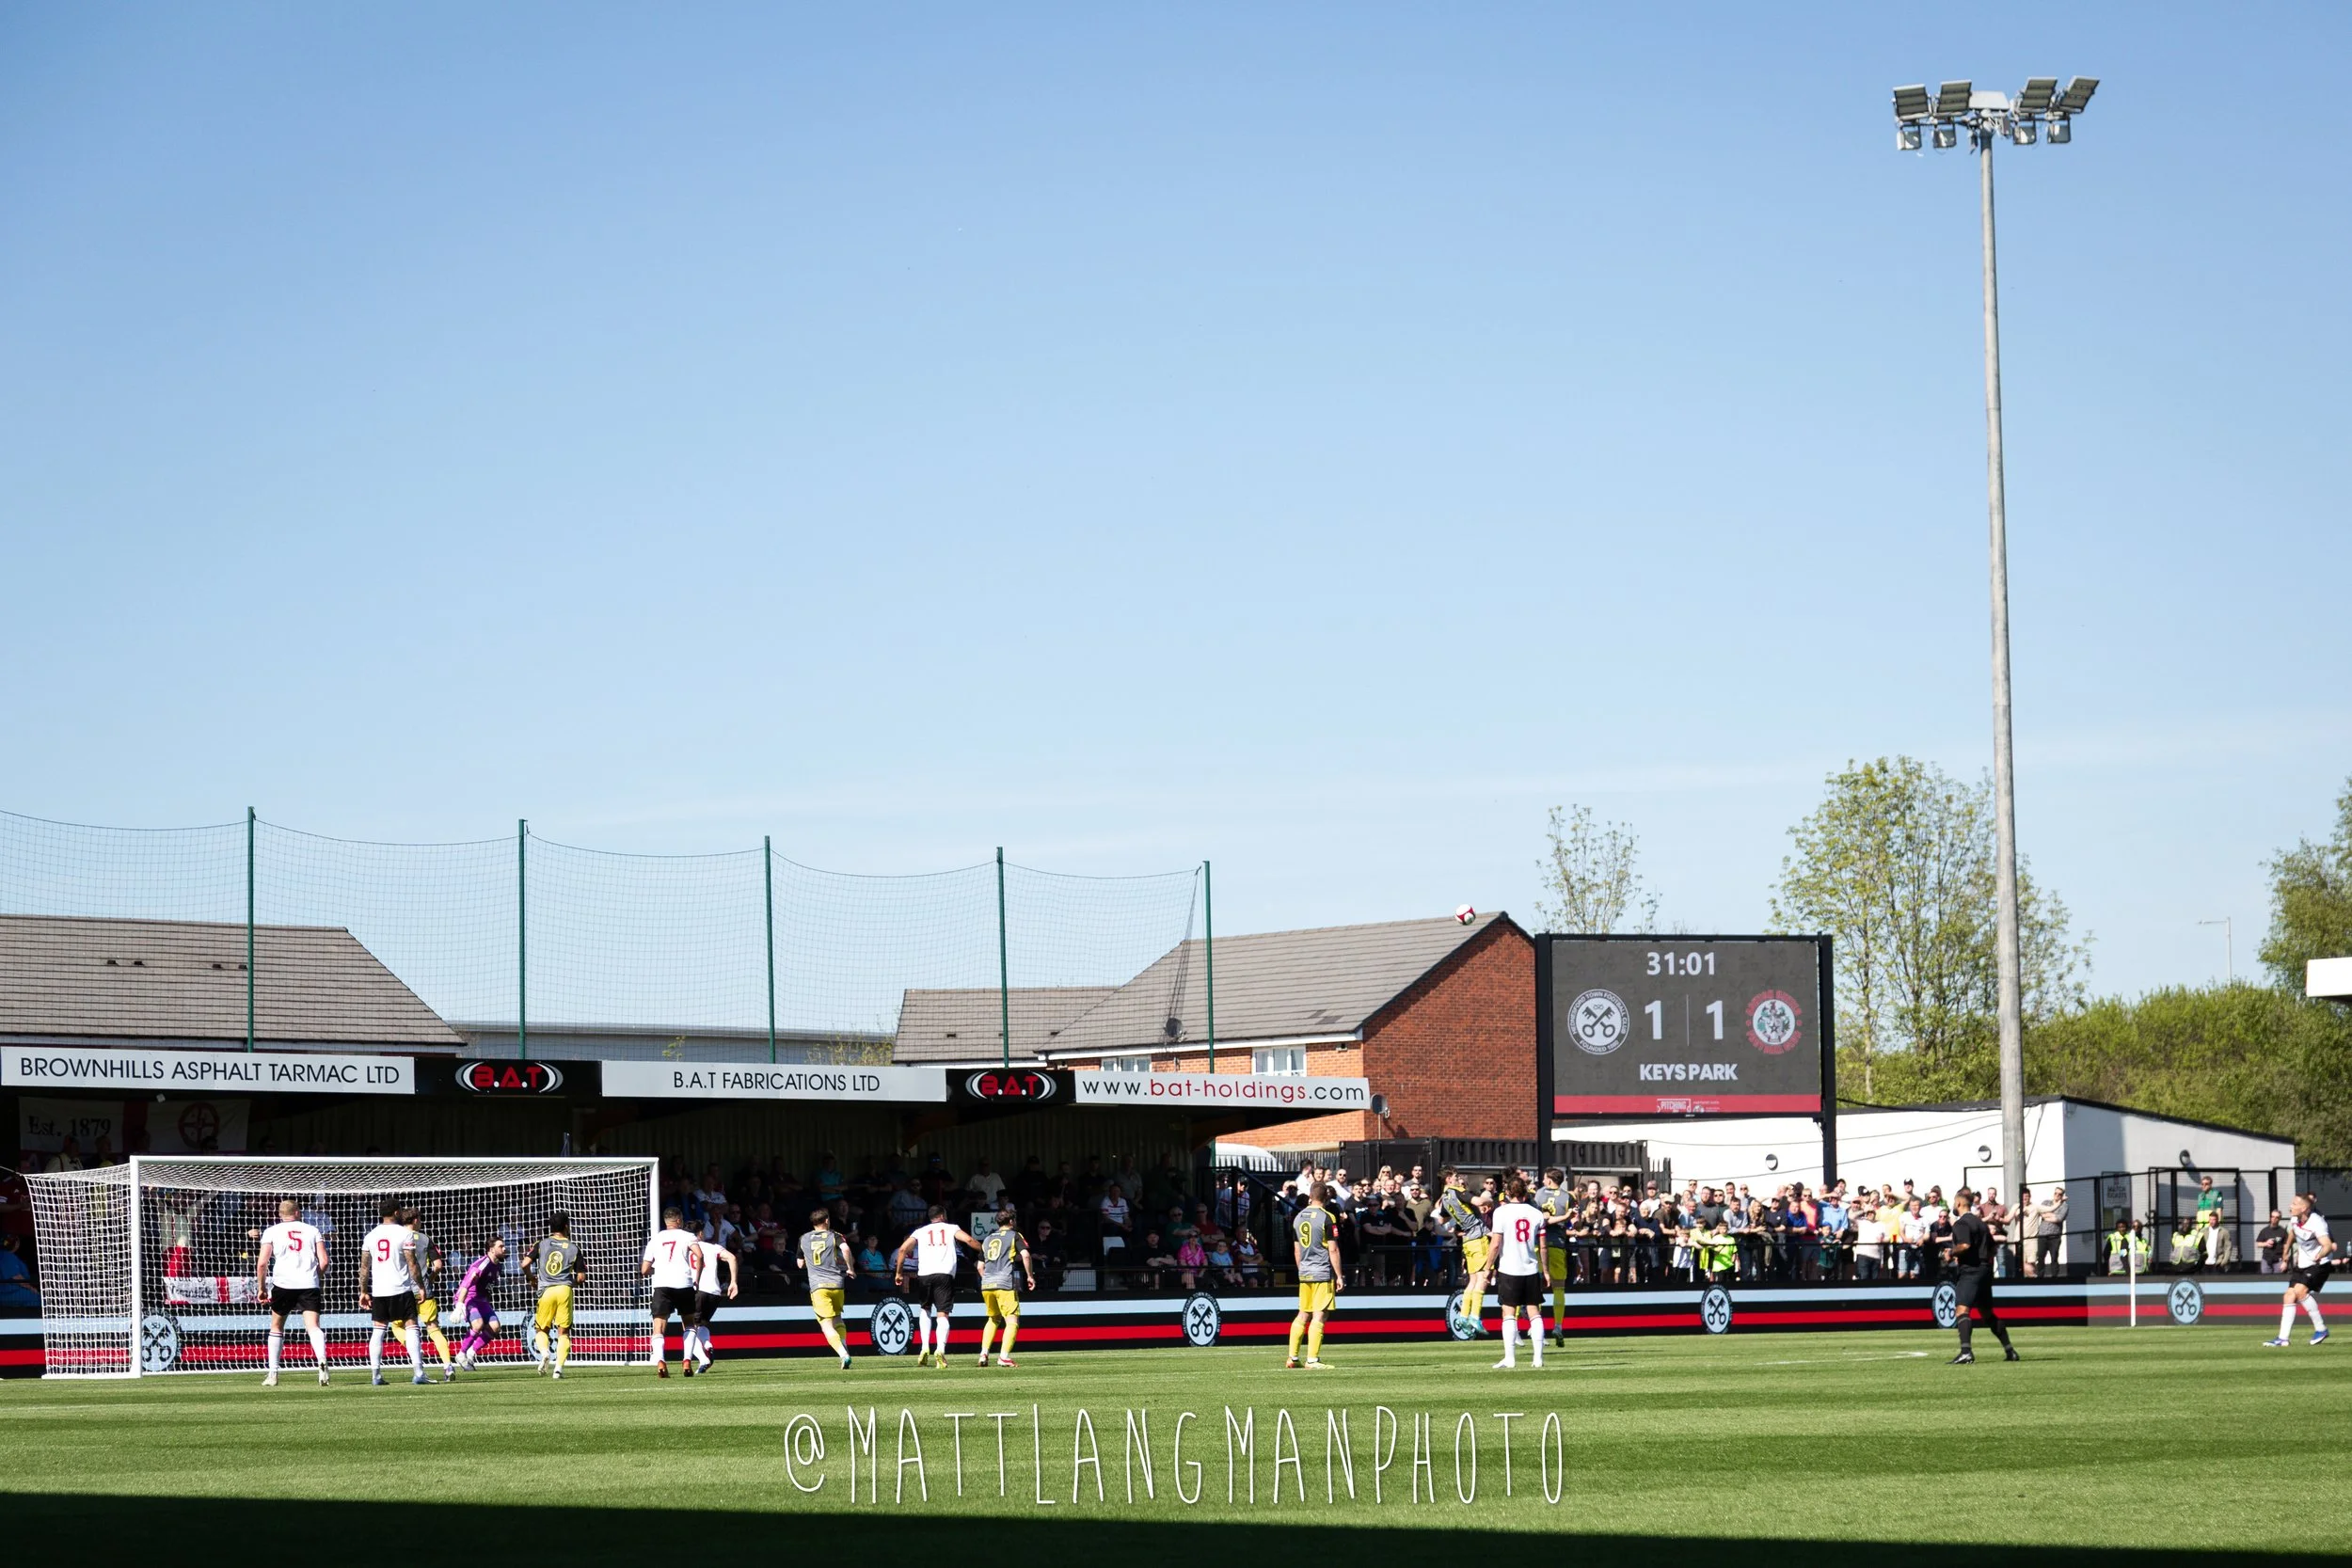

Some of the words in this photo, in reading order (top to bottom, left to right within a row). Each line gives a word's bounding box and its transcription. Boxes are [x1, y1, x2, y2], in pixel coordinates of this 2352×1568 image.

[1646, 951, 1715, 975] 31:01
[1645, 1000, 1662, 1040] 1
[1706, 1000, 1724, 1040] 1
[20, 1056, 165, 1080] BROWNHILLS
[171, 1060, 262, 1082] ASPHALT
[268, 1063, 358, 1083] TARMAC
[366, 1066, 400, 1085] LTD
[474, 1065, 543, 1089] B.A.T
[674, 1070, 717, 1089] B.A.T
[723, 1072, 847, 1091] FABRICATIONS
[852, 1074, 880, 1091] LTD
[1640, 1063, 1686, 1081] KEYS
[1688, 1063, 1739, 1081] PARK
[980, 1074, 1040, 1097] B.A.T
[1082, 1077, 1364, 1104] www.bat-holdings.com
[28, 1116, 61, 1137] Est.
[70, 1117, 111, 1136] 1879
[287, 1230, 303, 1252] 5
[927, 1228, 947, 1247] 11
[1298, 1221, 1312, 1249] 9
[1515, 1218, 1531, 1243] 8
[376, 1239, 390, 1262] 9
[661, 1241, 676, 1262] 7
[809, 1241, 826, 1266] 7
[545, 1251, 564, 1276] 8
